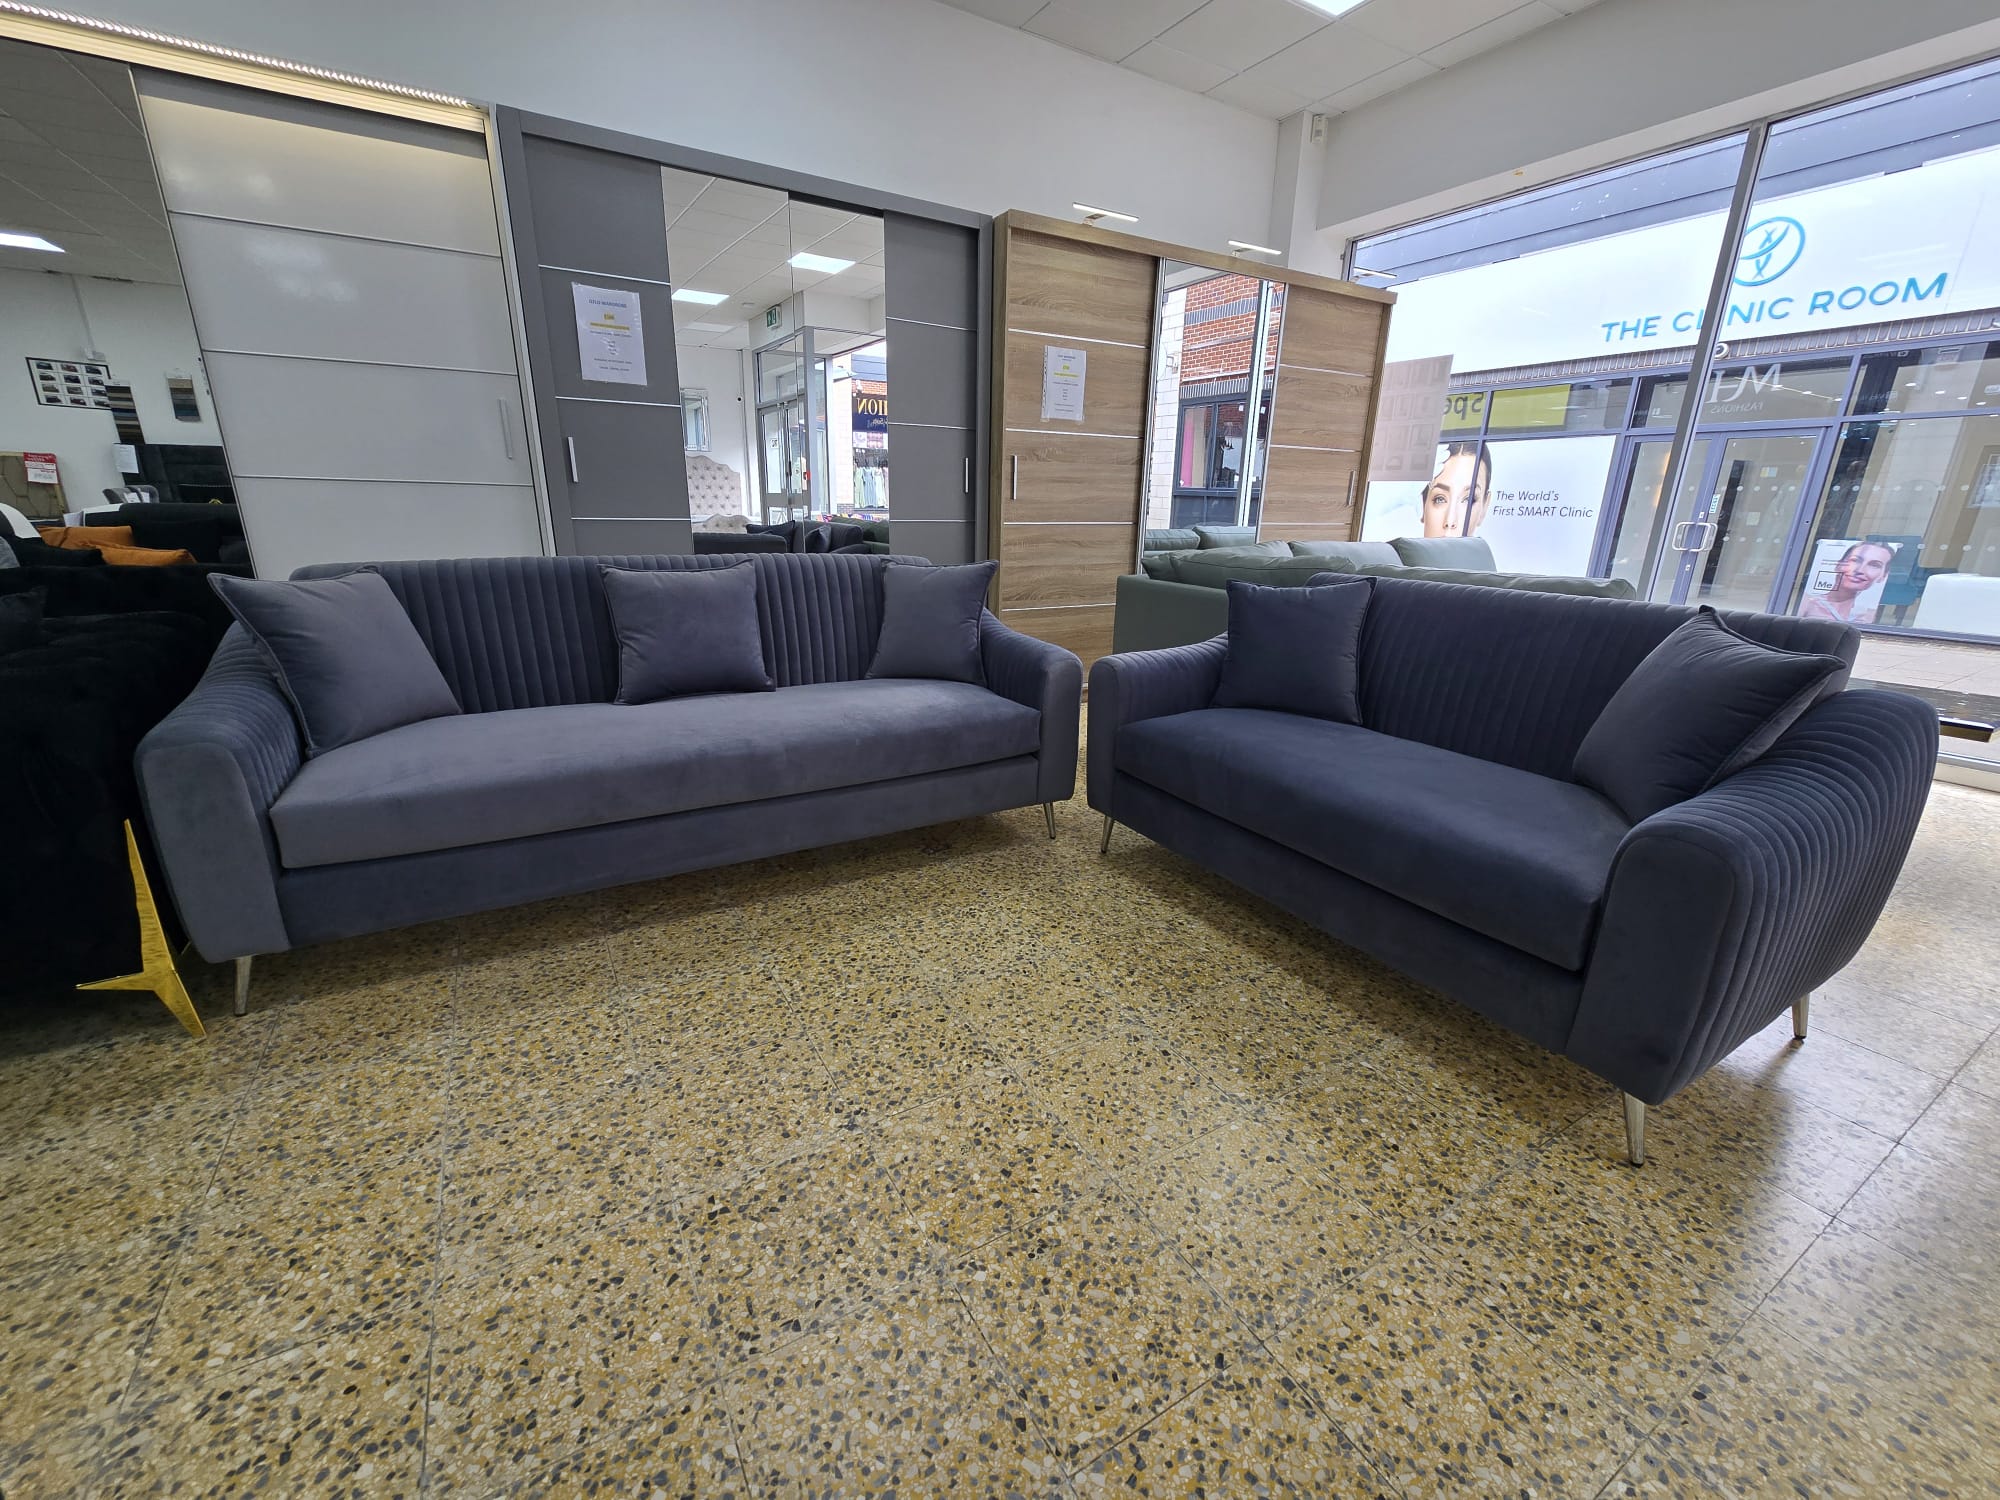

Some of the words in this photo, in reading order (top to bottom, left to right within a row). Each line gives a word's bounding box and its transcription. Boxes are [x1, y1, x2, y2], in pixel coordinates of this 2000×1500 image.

[1601, 315, 1663, 342] THE
[1672, 296, 1794, 333] CLNIC
[1807, 272, 1949, 316] ROOM
[1496, 490, 1515, 501] The
[1518, 490, 1560, 501] World's
[1493, 506, 1515, 516] First
[1517, 506, 1557, 517] SMART
[1559, 506, 1594, 518] Clinic
[1817, 580, 1833, 589] Me
